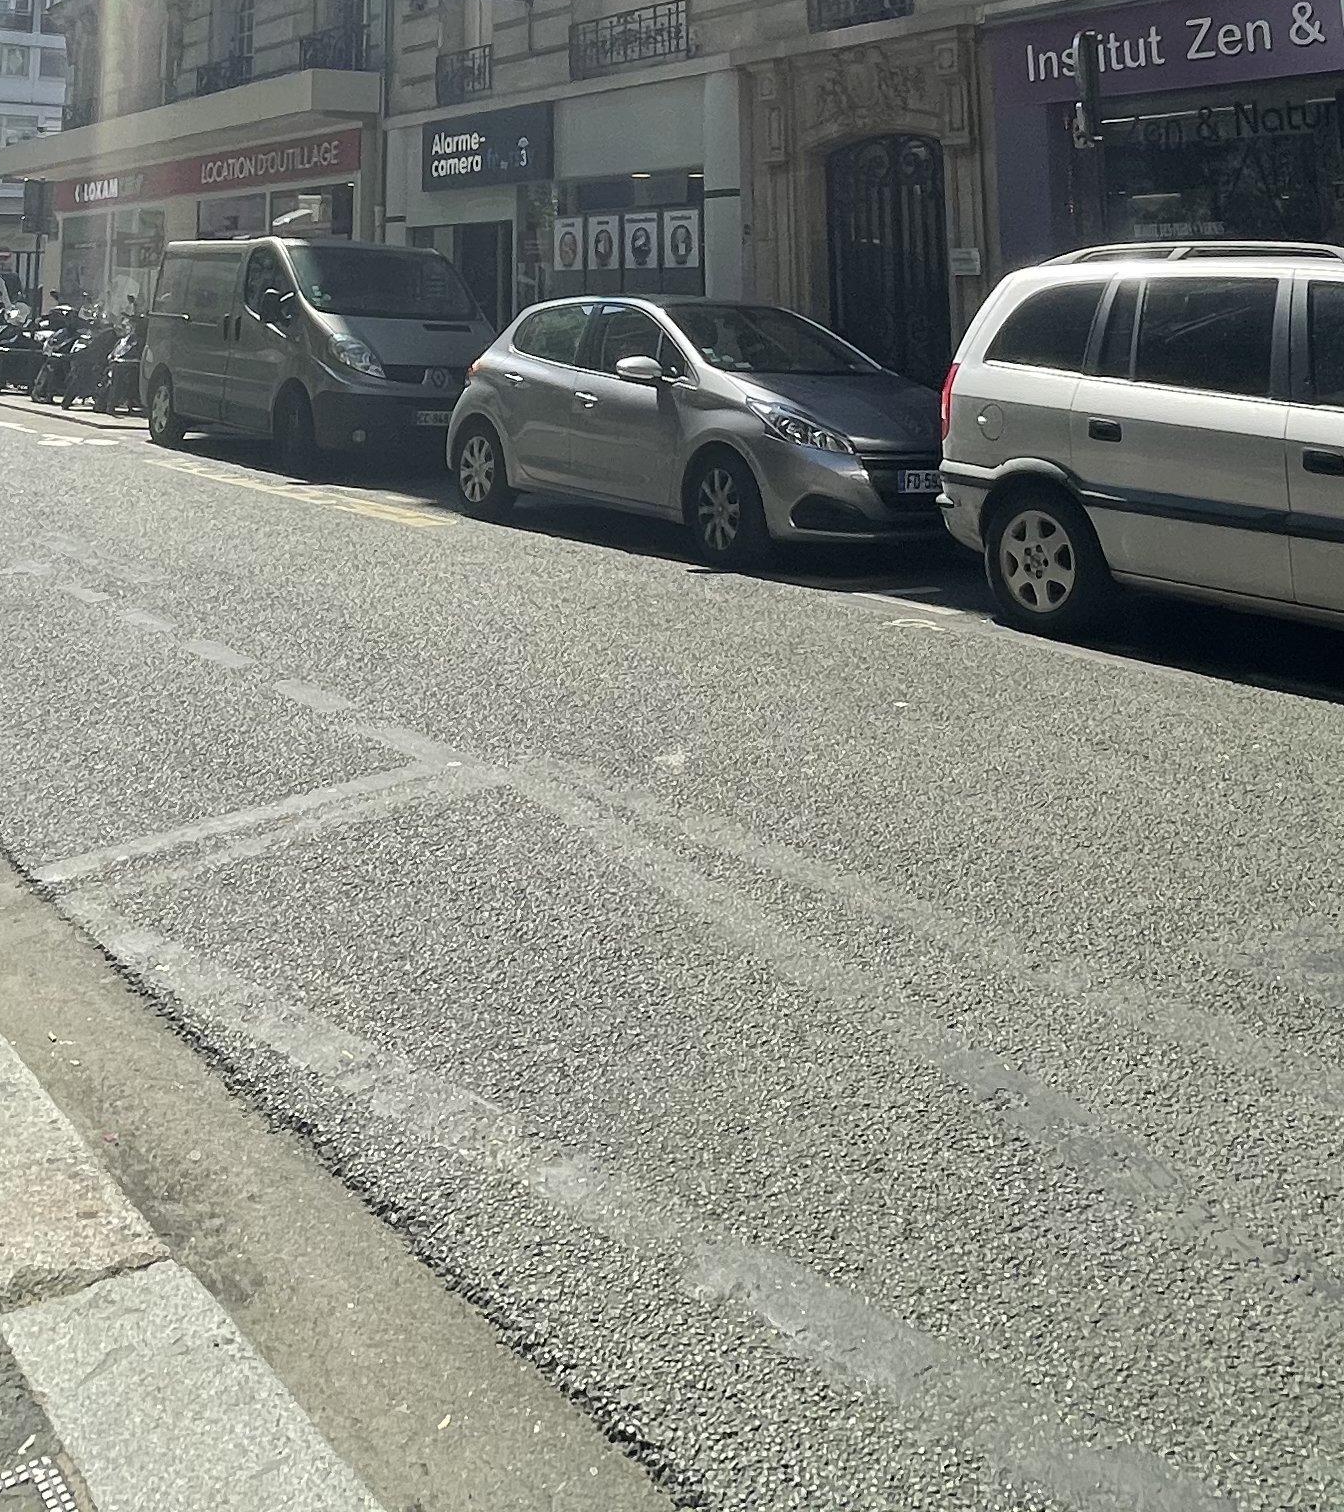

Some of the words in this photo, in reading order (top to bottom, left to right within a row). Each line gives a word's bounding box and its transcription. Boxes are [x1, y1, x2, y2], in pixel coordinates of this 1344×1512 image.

[1027, 25, 1166, 82] Insitut
[1185, 17, 1273, 61] Zen
[1288, 0, 1326, 48] &
[1234, 99, 1332, 137] Natur
[431, 131, 486, 156] Alarme-
[84, 177, 118, 202] LOXAM
[201, 156, 255, 184] LOCATION
